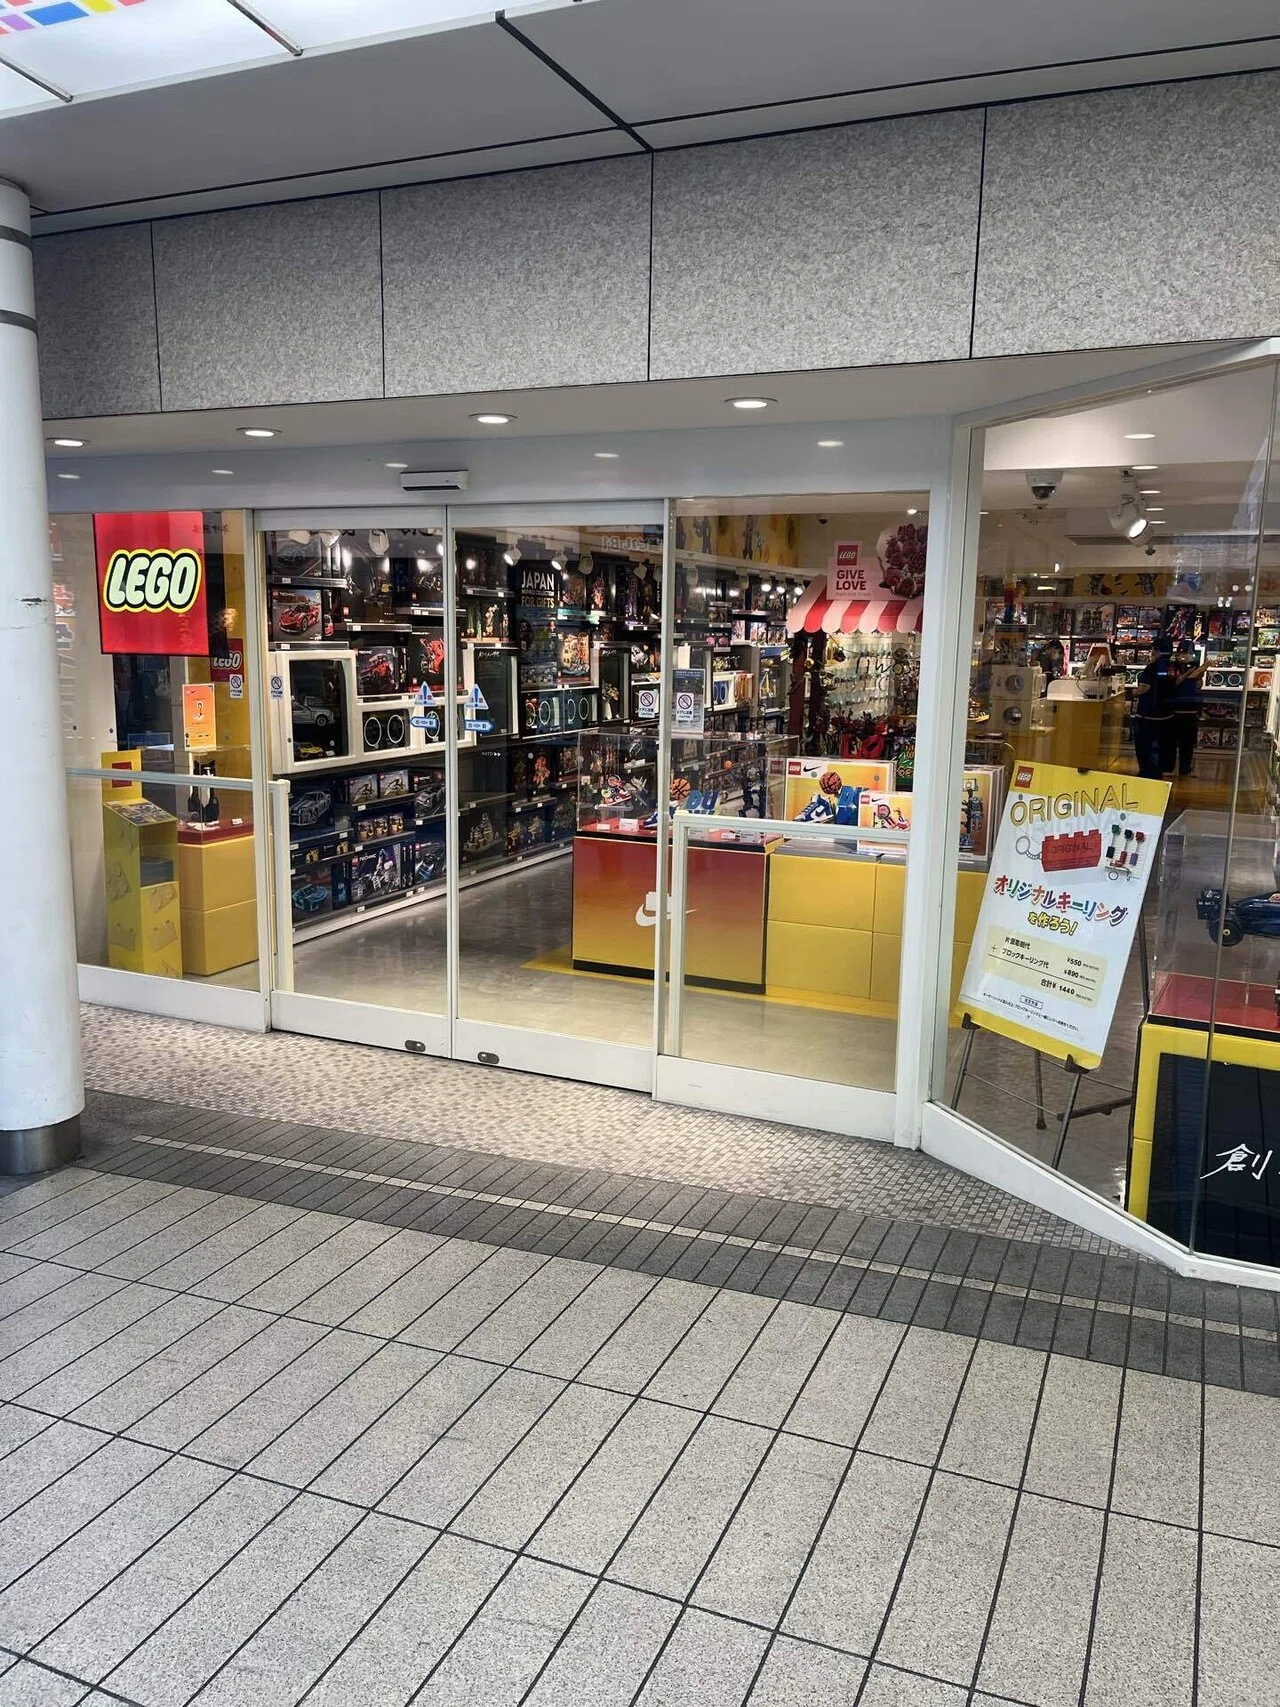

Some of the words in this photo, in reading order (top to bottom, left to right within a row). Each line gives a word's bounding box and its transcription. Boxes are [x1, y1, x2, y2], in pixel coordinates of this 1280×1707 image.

[839, 551, 856, 560] LEGO
[105, 551, 199, 610] LEGO
[521, 570, 555, 591] JAPAN
[837, 569, 865, 580] GIVE
[836, 580, 867, 591] LOVE
[521, 596, 535, 608] FOR
[536, 597, 555, 609] GIFTS
[1017, 770, 1031, 782] LEGO
[1010, 782, 1139, 827] ORIGINAL
[1051, 841, 1095, 854] ORIGINAL
[994, 875, 1129, 927] オリジナルキーリング
[1002, 947, 1050, 969] ブロックキーリング代
[1199, 1143, 1280, 1181] 創
